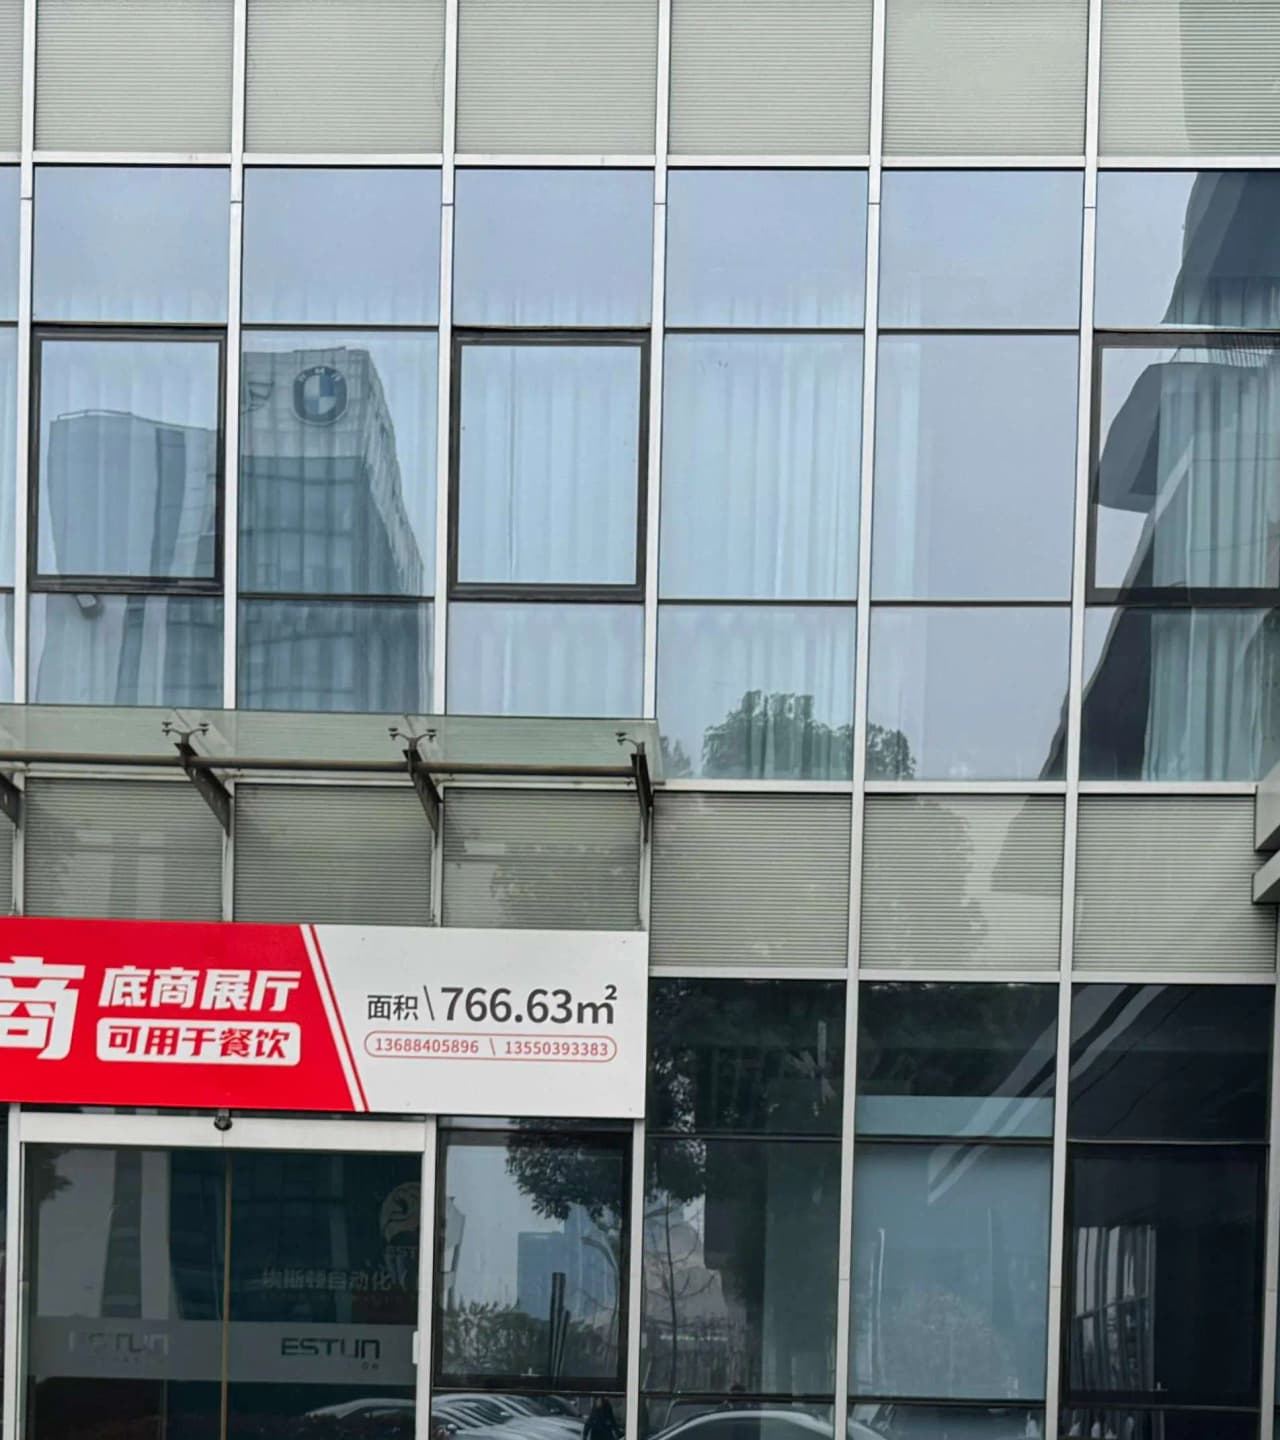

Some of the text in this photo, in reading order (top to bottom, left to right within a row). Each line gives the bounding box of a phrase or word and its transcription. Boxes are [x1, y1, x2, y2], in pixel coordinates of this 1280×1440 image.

[98, 965, 302, 1012] 底商展厅
[367, 994, 419, 1021] 面积
[108, 1025, 290, 1059] 可用于餐饮
[375, 1038, 609, 1057] 13688405896 13550393383
